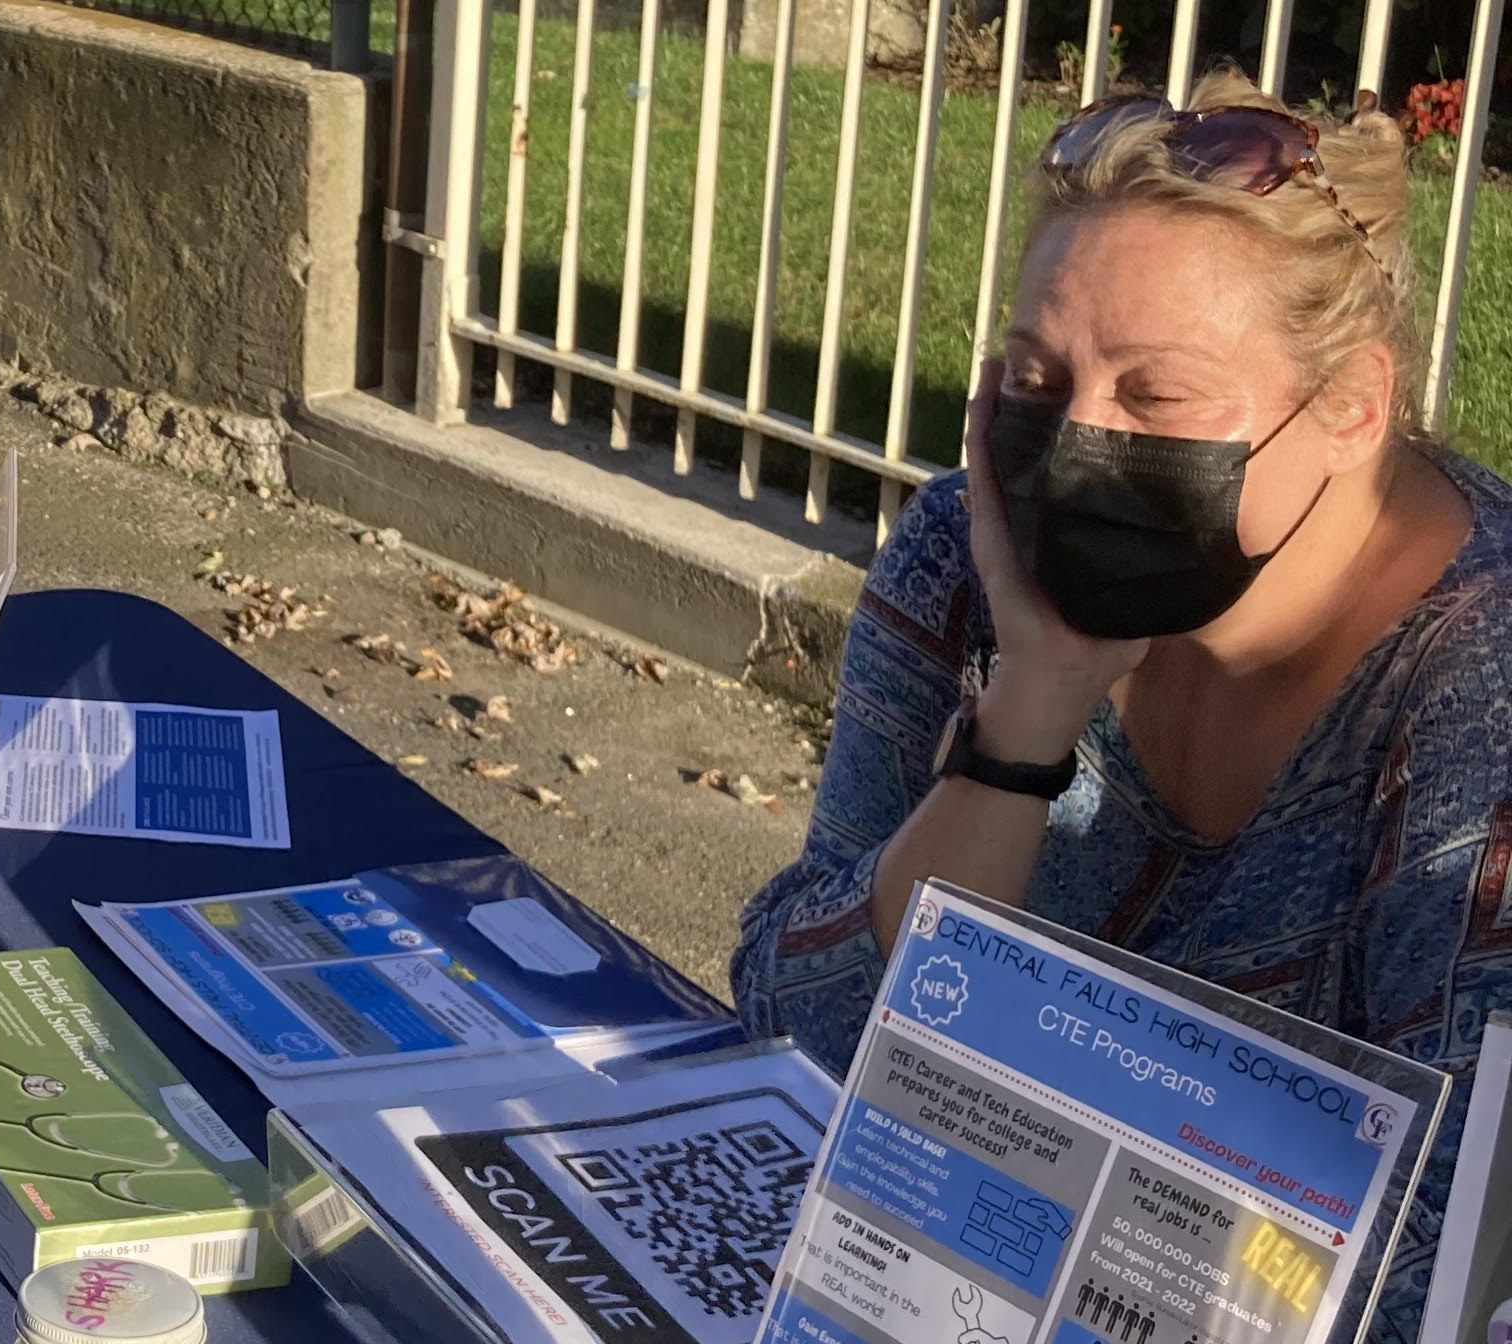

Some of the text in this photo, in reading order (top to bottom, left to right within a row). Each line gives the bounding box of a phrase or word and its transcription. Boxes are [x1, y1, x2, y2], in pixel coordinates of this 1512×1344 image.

[920, 977, 959, 1003] NEW
[937, 915, 1355, 1125] CENTRAL FALLS HIGH SCHOOL
[1, 960, 111, 1083] Dual Head Stethoscope
[1038, 1004, 1218, 1107] CTE Programs
[196, 1104, 239, 1150] VERIDIAN
[887, 1069, 1059, 1165] prepares you for college and
[888, 1045, 1074, 1150] (CTE) Career and Tech Education
[864, 1108, 948, 1159] BUILD A SOLID BASE!
[886, 1136, 928, 1168] technical
[927, 1161, 950, 1180] and
[918, 1106, 1009, 1158] career success!
[855, 1144, 916, 1186] employability
[859, 1165, 876, 1182] the
[876, 1175, 927, 1211] knowledge
[926, 1203, 948, 1223] you
[1177, 1122, 1356, 1219] Discover your path!
[871, 1191, 883, 1206] to
[1128, 1167, 1236, 1232] The DEMAND for
[1133, 1194, 1202, 1237] real jobs is
[82, 1243, 151, 1258] Model 05-132
[464, 1164, 657, 1333] SCAN ME
[832, 1211, 911, 1263] ADD IN HANDS ON
[838, 1237, 887, 1273] LEARNING!
[1241, 1221, 1323, 1314] REAL
[65, 1260, 140, 1331] SHARK
[492, 1253, 569, 1328] SCAN HERE!
[821, 1273, 887, 1320] REAL world!
[823, 1248, 921, 1317] is important in the
[1089, 1251, 1198, 1317] from 2021 2022
[1100, 1232, 1125, 1254] Will
[1123, 1247, 1154, 1272] open
[1154, 1259, 1177, 1281] for
[1177, 1273, 1204, 1298] CTE
[1203, 1289, 1274, 1334] graduates
[1191, 1258, 1231, 1288] JOBS
